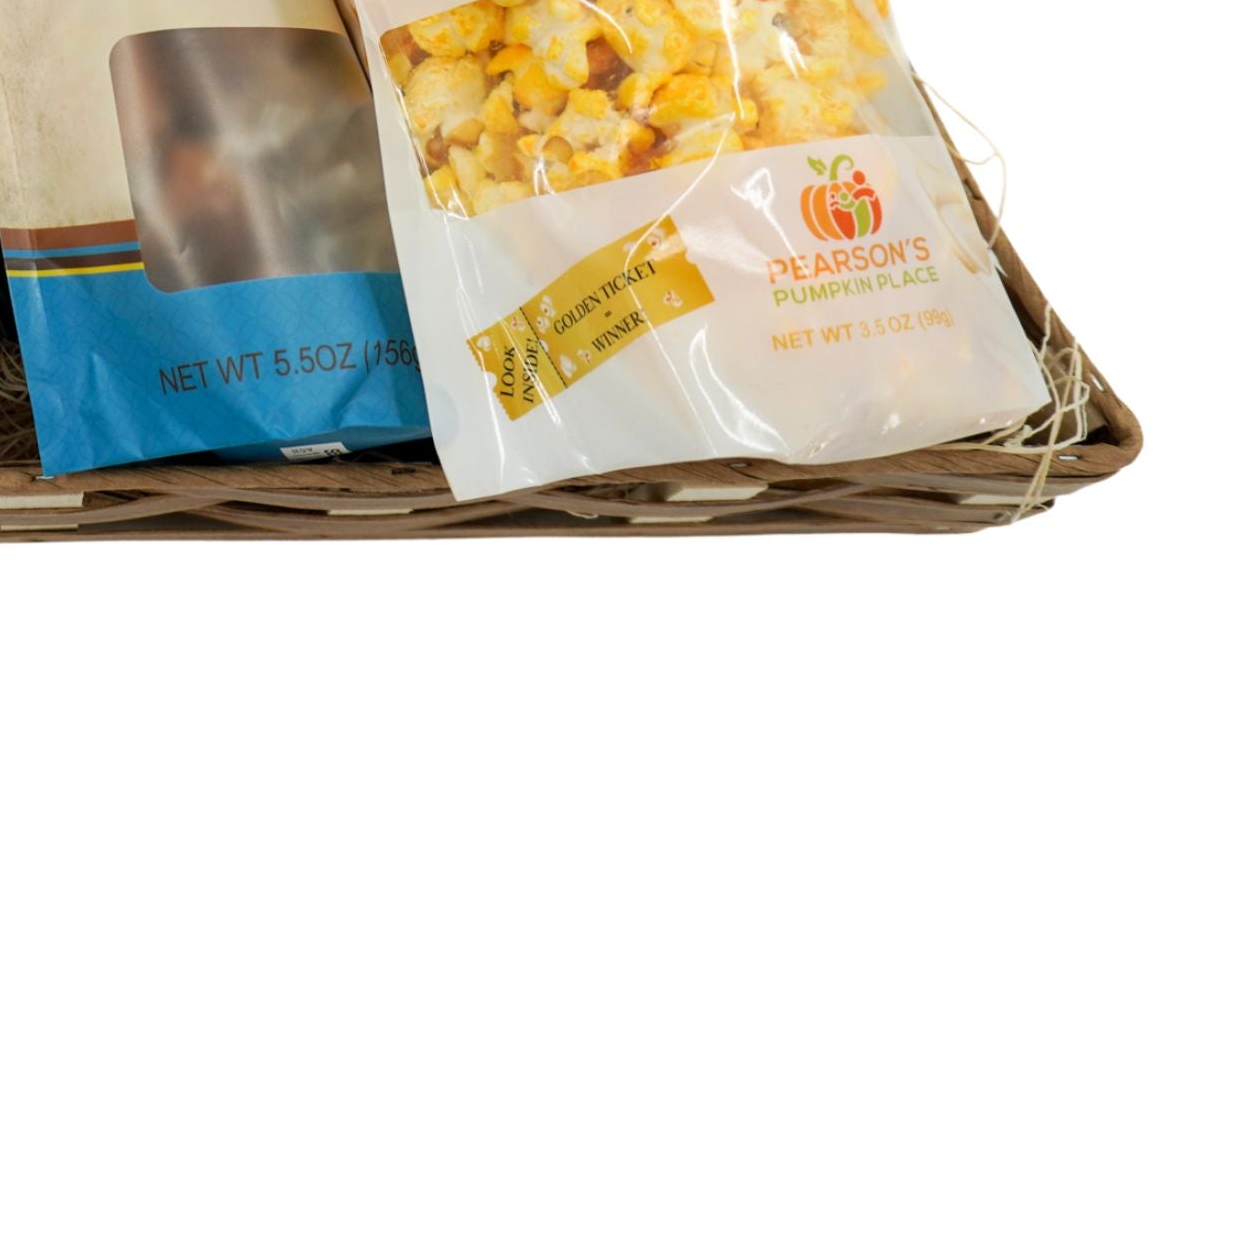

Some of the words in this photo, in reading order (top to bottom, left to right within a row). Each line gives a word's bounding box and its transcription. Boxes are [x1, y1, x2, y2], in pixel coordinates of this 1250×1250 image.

[766, 236, 931, 284] PEARSON'S
[553, 292, 602, 335] GOLDEN
[598, 259, 657, 301] TICKET
[773, 276, 874, 307] PUMPKIN
[876, 266, 940, 290] PLACE
[772, 329, 814, 351] NET
[821, 324, 853, 344] WT
[859, 319, 885, 339] 3.5
[888, 314, 914, 332] OZ
[918, 308, 954, 330] (99g)
[159, 361, 208, 395] NET
[217, 352, 263, 385] WT
[274, 343, 358, 377] 5.5OZ
[500, 345, 517, 398] LOOK
